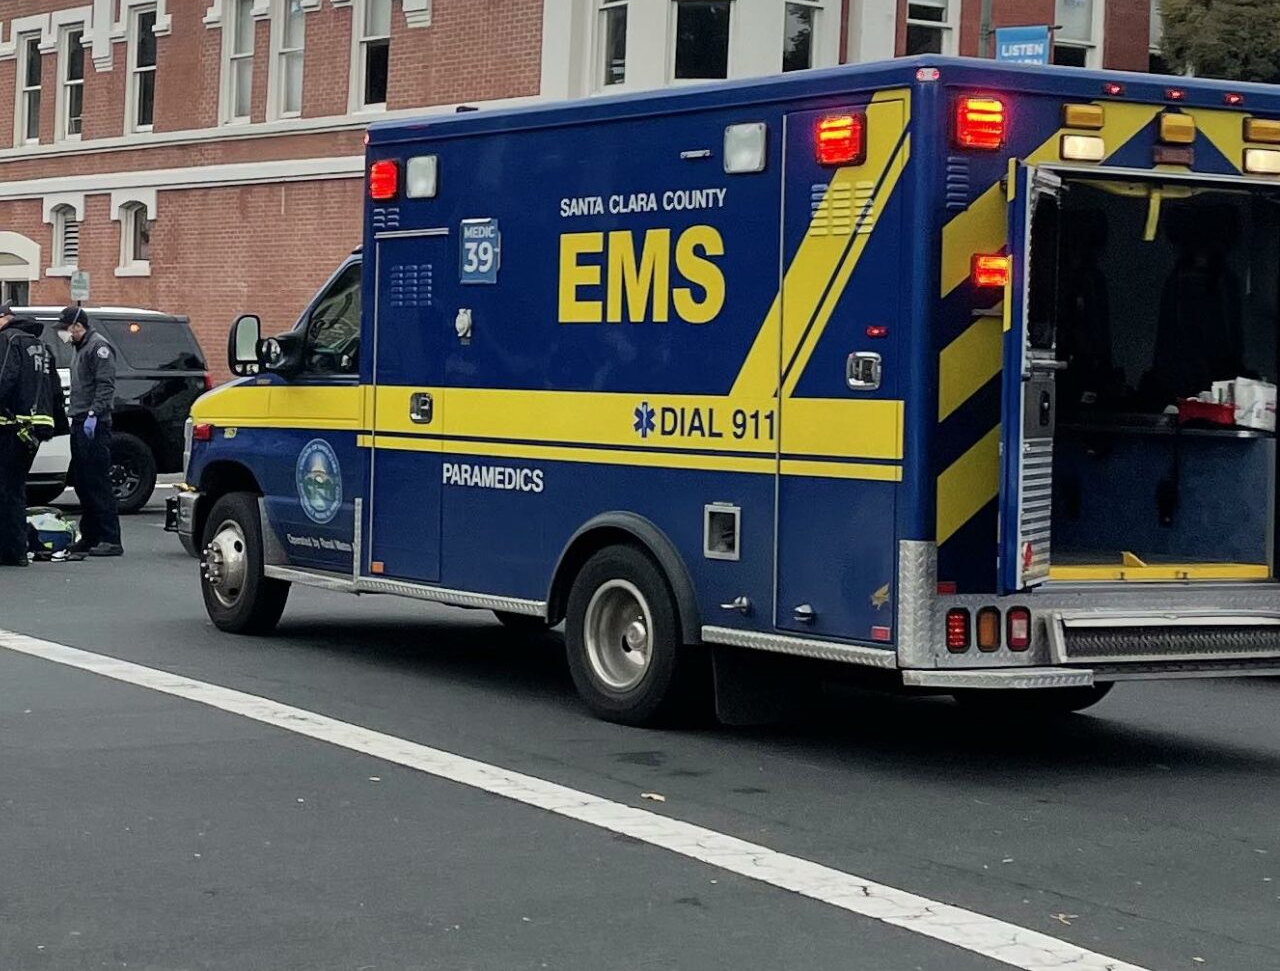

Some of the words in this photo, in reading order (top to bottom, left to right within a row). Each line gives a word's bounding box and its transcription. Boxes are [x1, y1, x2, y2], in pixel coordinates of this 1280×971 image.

[1001, 43, 1044, 57] LISTEN
[559, 196, 605, 218] SANTA
[608, 192, 658, 215] CLARA
[662, 187, 727, 212] COUNTY
[463, 225, 496, 239] MEDIC
[463, 241, 494, 273] 39
[558, 224, 726, 324] EMS
[660, 407, 723, 438] DIAL
[732, 409, 775, 441] 911
[442, 462, 544, 493] PARAMEDICS
